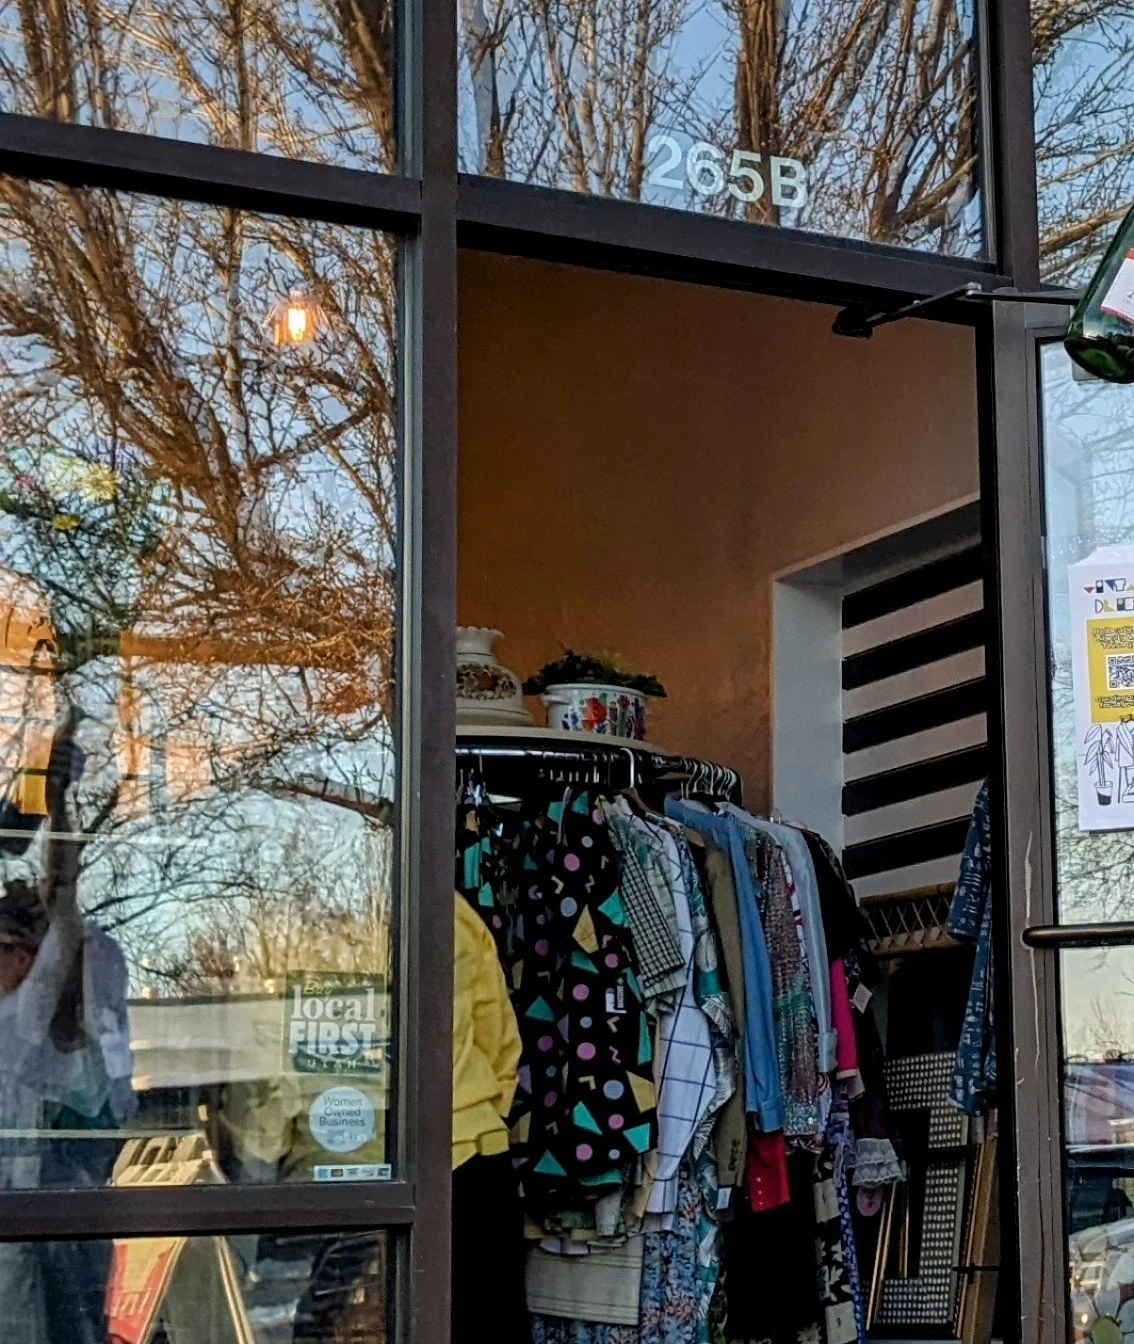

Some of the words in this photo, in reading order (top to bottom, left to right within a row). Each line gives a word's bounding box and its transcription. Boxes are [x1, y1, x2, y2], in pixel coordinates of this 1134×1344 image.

[648, 134, 809, 208] 265B
[291, 985, 376, 1021] local
[288, 1021, 376, 1055] FIRST
[307, 1058, 358, 1069] UTAH
[324, 1096, 363, 1107] Women
[324, 1106, 361, 1117] Owned
[319, 1116, 366, 1127] Business
